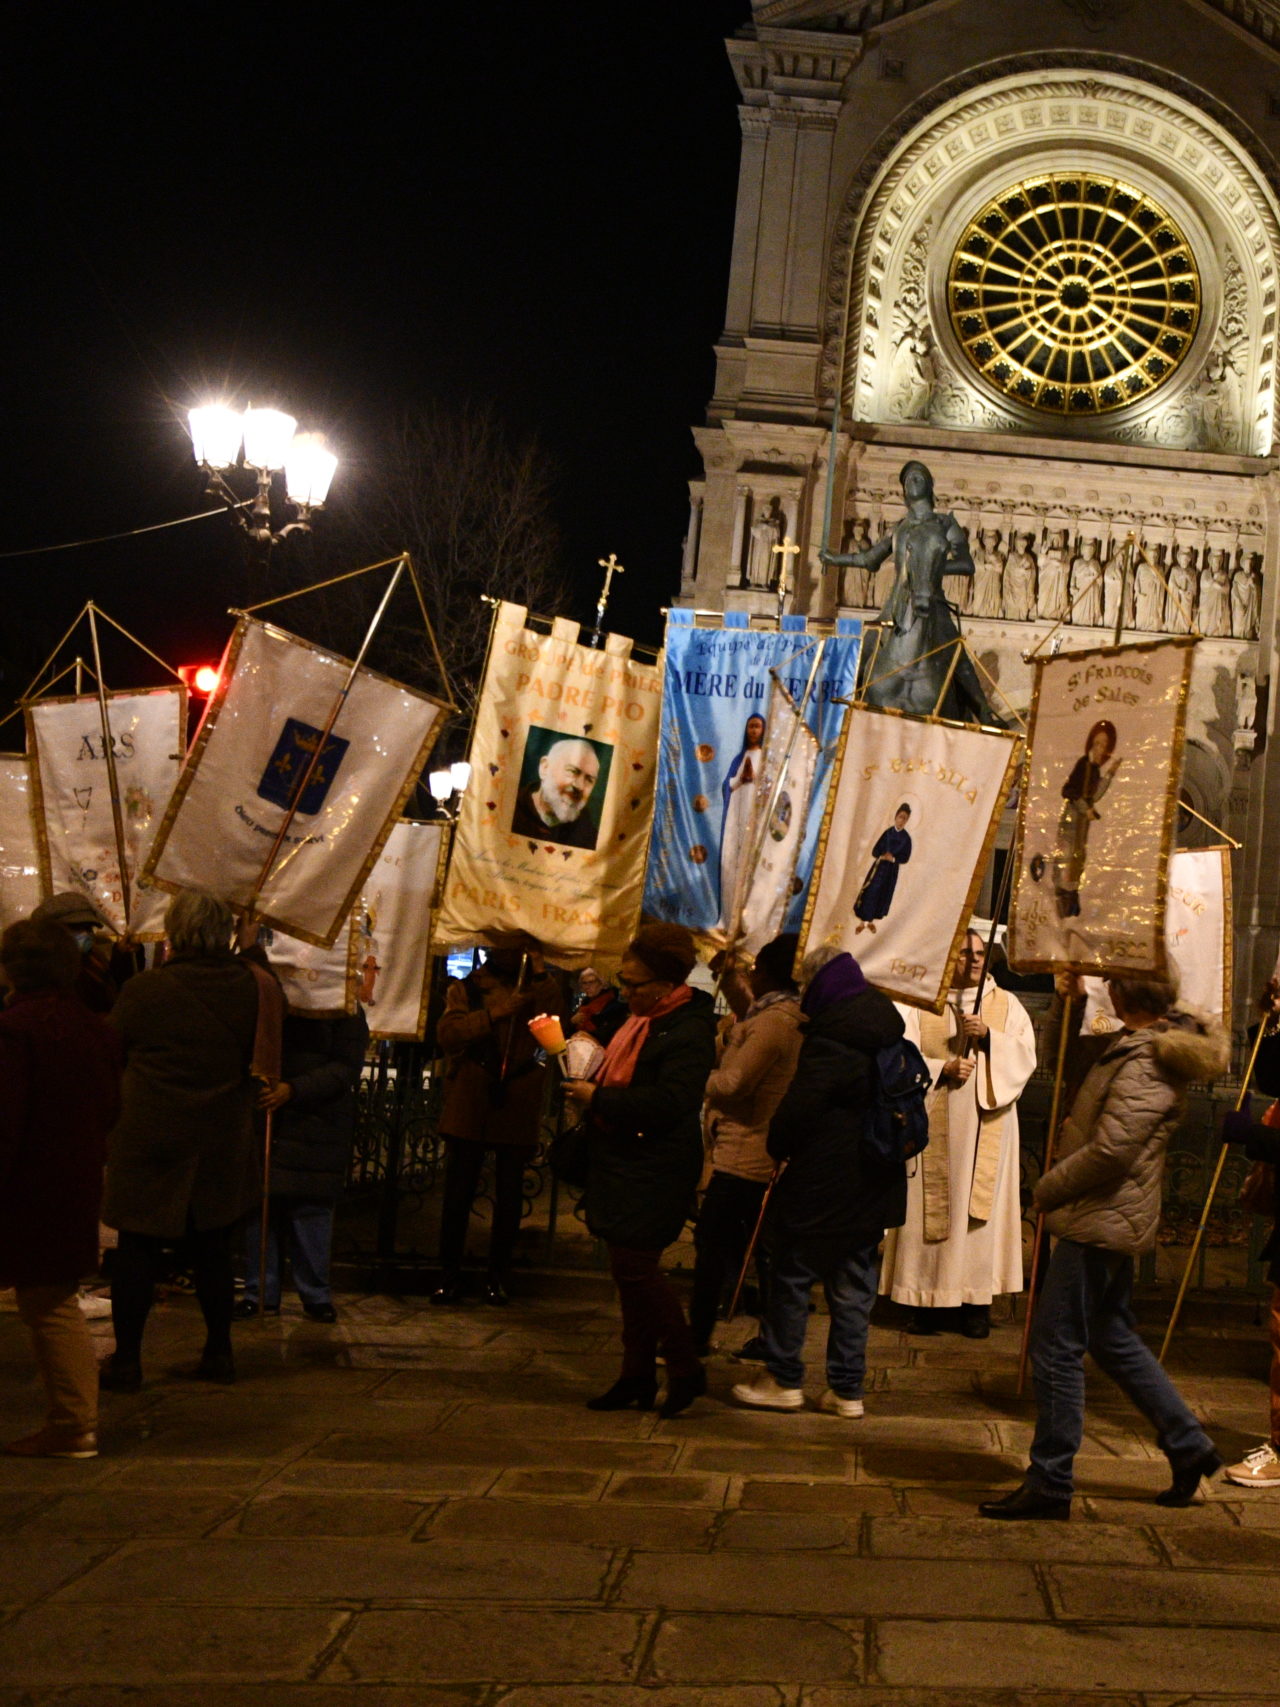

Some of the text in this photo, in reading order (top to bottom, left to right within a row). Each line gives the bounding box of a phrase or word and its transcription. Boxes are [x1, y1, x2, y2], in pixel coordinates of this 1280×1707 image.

[514, 671, 646, 722] PADRE PIO
[672, 666, 738, 699] MÈRE
[743, 676, 765, 699] du
[75, 732, 136, 762] ARS
[451, 881, 522, 914] PARIS
